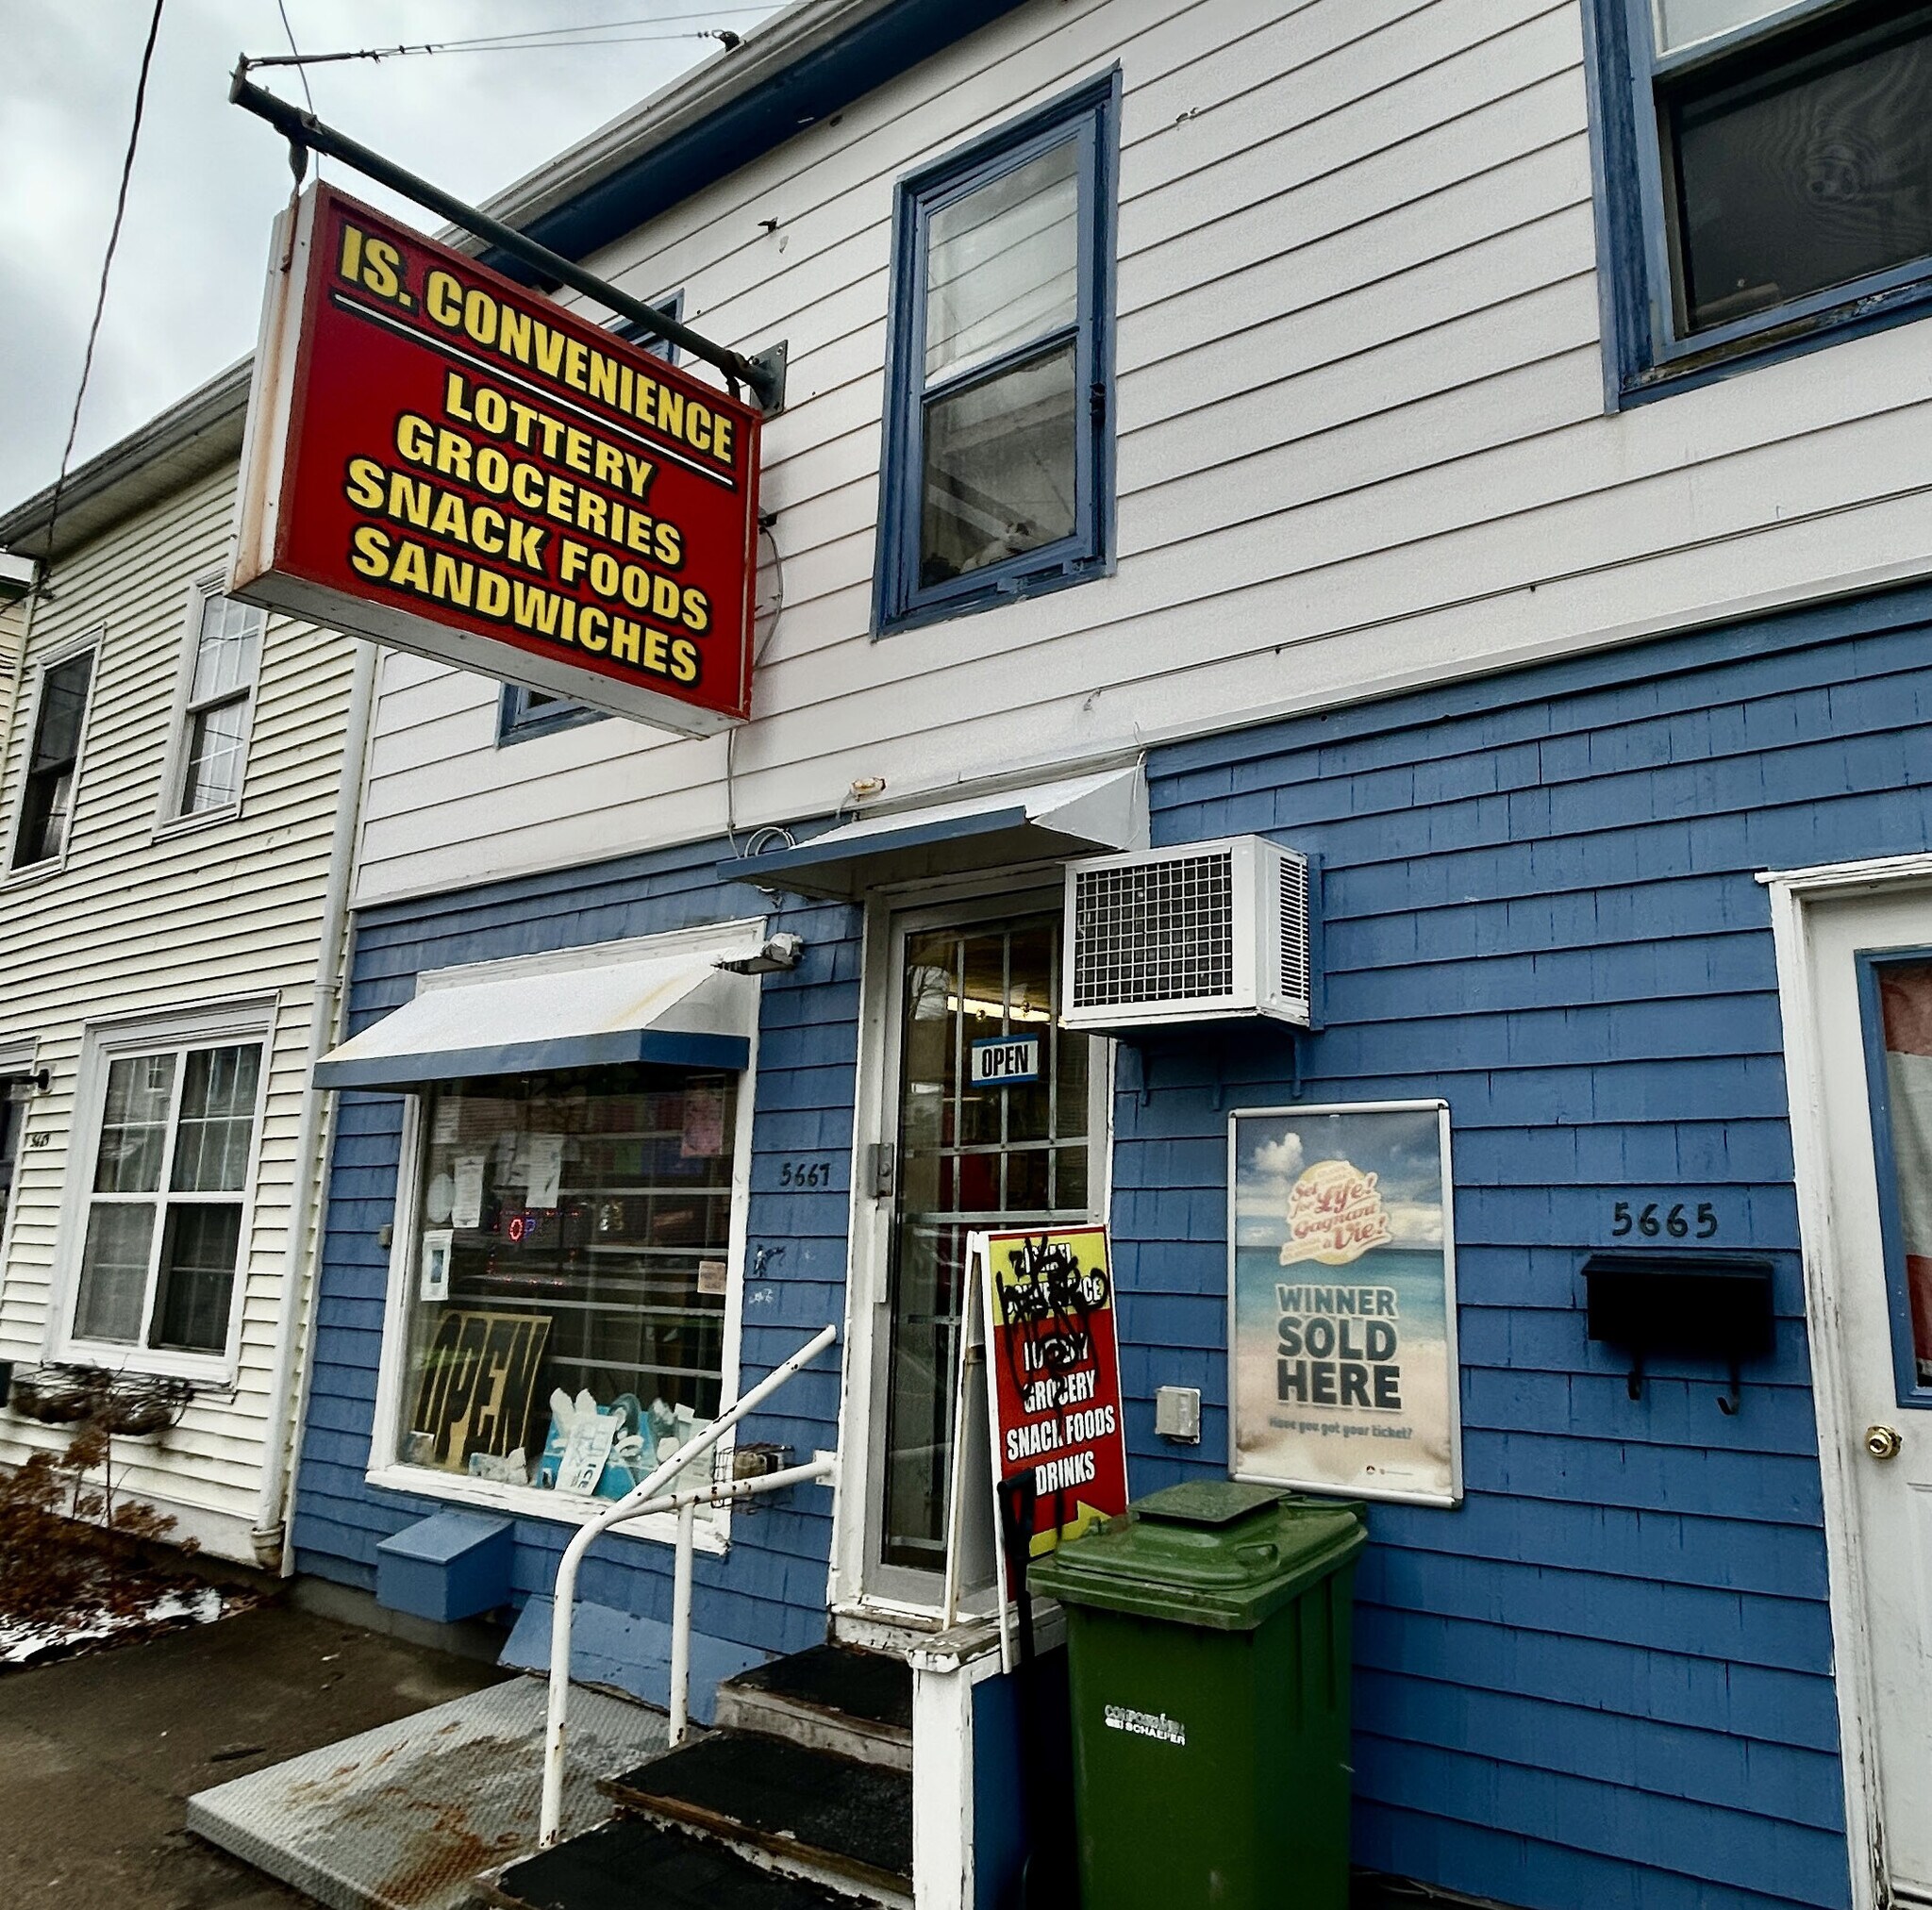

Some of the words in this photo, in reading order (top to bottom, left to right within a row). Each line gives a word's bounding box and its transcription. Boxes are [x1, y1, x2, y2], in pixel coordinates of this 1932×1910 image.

[341, 224, 412, 307] IS.
[427, 270, 733, 464] CONVENIENCE
[445, 372, 654, 497] LOTTERY
[397, 414, 681, 568] GROCERIES
[346, 458, 544, 572] SNACK
[561, 539, 709, 632] FOODS
[353, 526, 698, 683] SANDWICHES
[982, 1044, 1028, 1077] OPEN
[779, 1162, 830, 1187] 5667
[1314, 1176, 1374, 1214] Life!
[1333, 1216, 1387, 1250] Vie!
[1612, 1202, 1718, 1238] 5665
[1277, 1286, 1397, 1317] WINNER
[1277, 1318, 1397, 1362] SOLD
[414, 1313, 550, 1457] OPEN
[1277, 1359, 1402, 1410] HERE
[1065, 1404, 1116, 1445] FOODS
[1269, 1418, 1296, 1430] Have
[1299, 1421, 1320, 1434] you
[1322, 1422, 1340, 1436] got
[1343, 1425, 1369, 1437] your
[1372, 1425, 1413, 1439] ticket?
[1035, 1451, 1095, 1496] DRINKS
